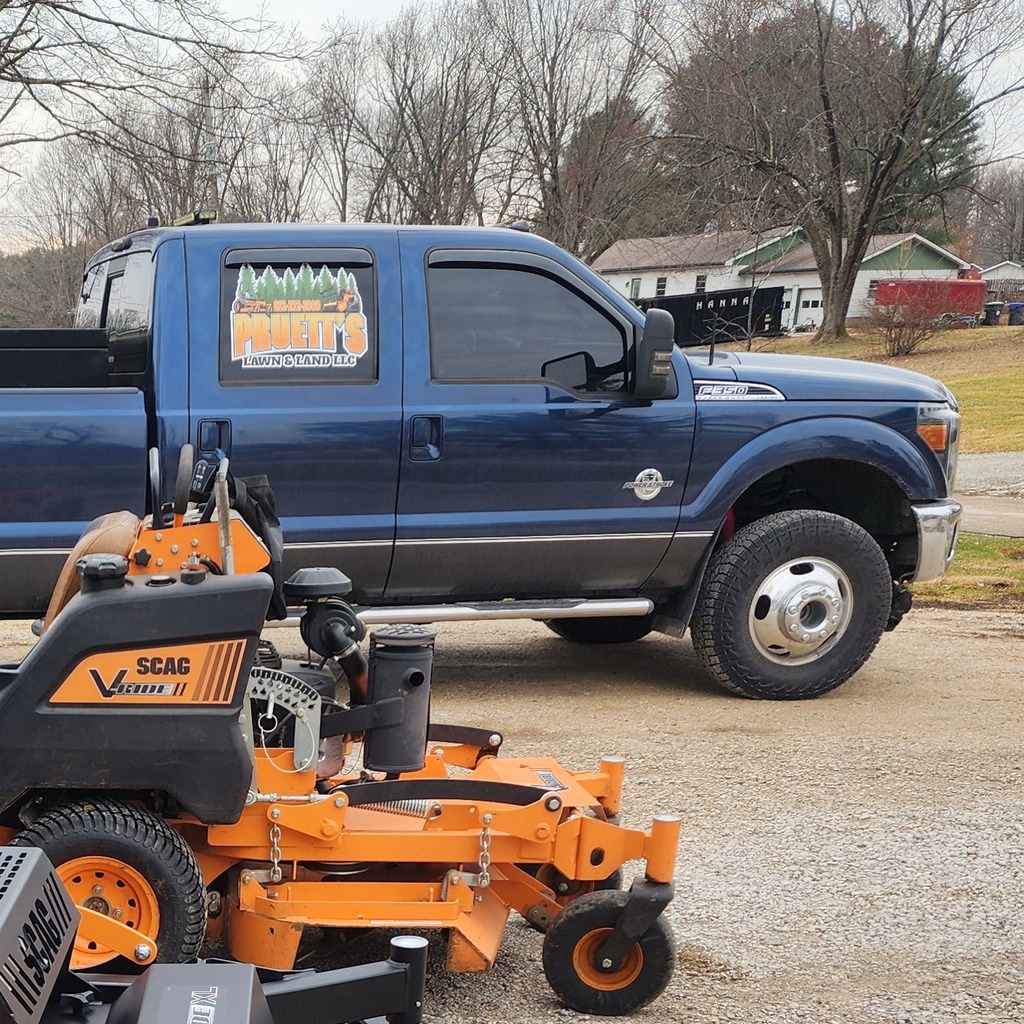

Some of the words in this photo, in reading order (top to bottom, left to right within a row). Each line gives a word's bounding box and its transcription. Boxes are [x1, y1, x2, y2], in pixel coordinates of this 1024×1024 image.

[696, 296, 750, 310] HANNA
[232, 312, 367, 357] PRUETT'S
[243, 355, 282, 367] LAWN
[284, 356, 292, 366] &
[296, 355, 331, 366] LAND
[333, 355, 356, 366] LLC
[136, 656, 190, 675] SCAG
[18, 898, 64, 988] SCAG
[190, 986, 218, 1005] XL
